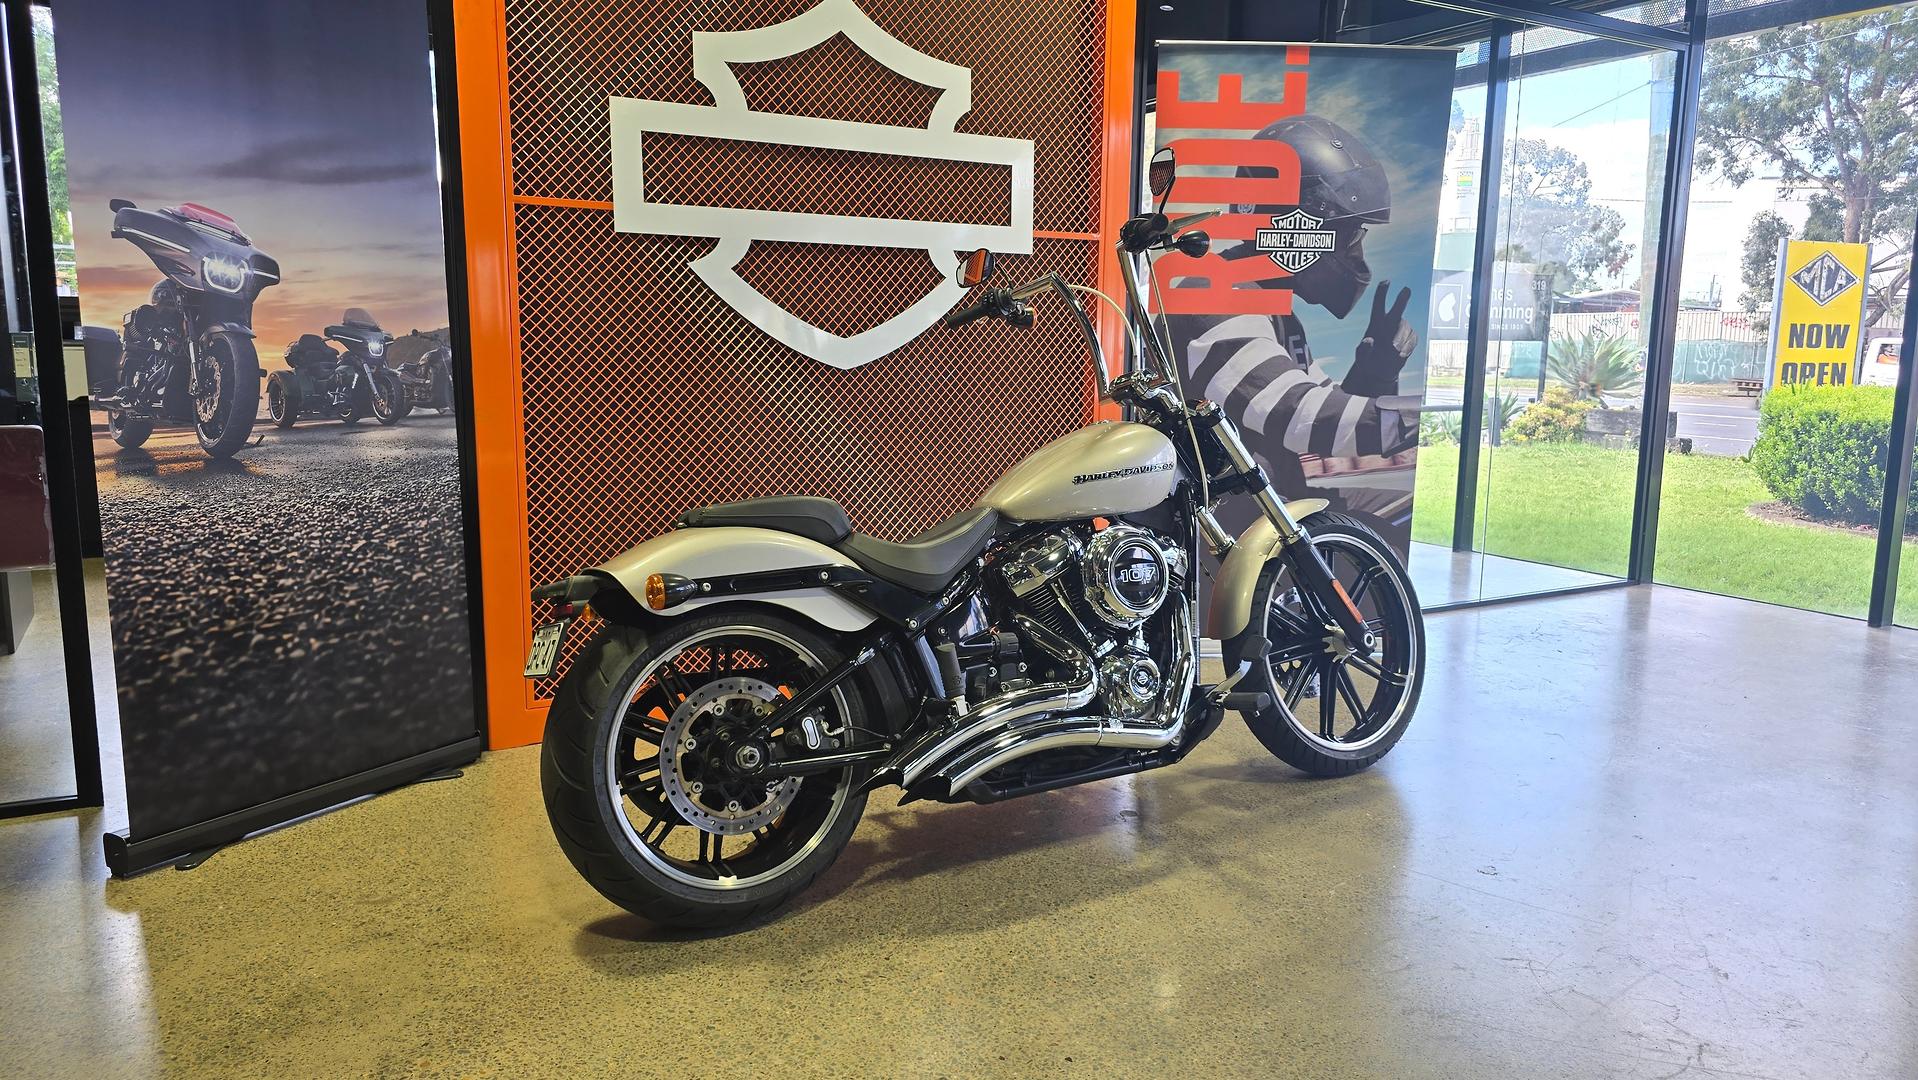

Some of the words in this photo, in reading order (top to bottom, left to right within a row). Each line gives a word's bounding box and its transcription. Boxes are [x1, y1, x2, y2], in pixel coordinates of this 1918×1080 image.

[1278, 213, 1317, 230] MOTOR
[1260, 233, 1333, 248] HARLEY-DAVIDSON
[1276, 251, 1315, 270] CYCLES
[1531, 280, 1547, 291] 319
[1800, 256, 1848, 300] MCA
[1788, 323, 1851, 349] NOW
[1780, 362, 1847, 387] OPEN
[1120, 566, 1156, 583] 107
